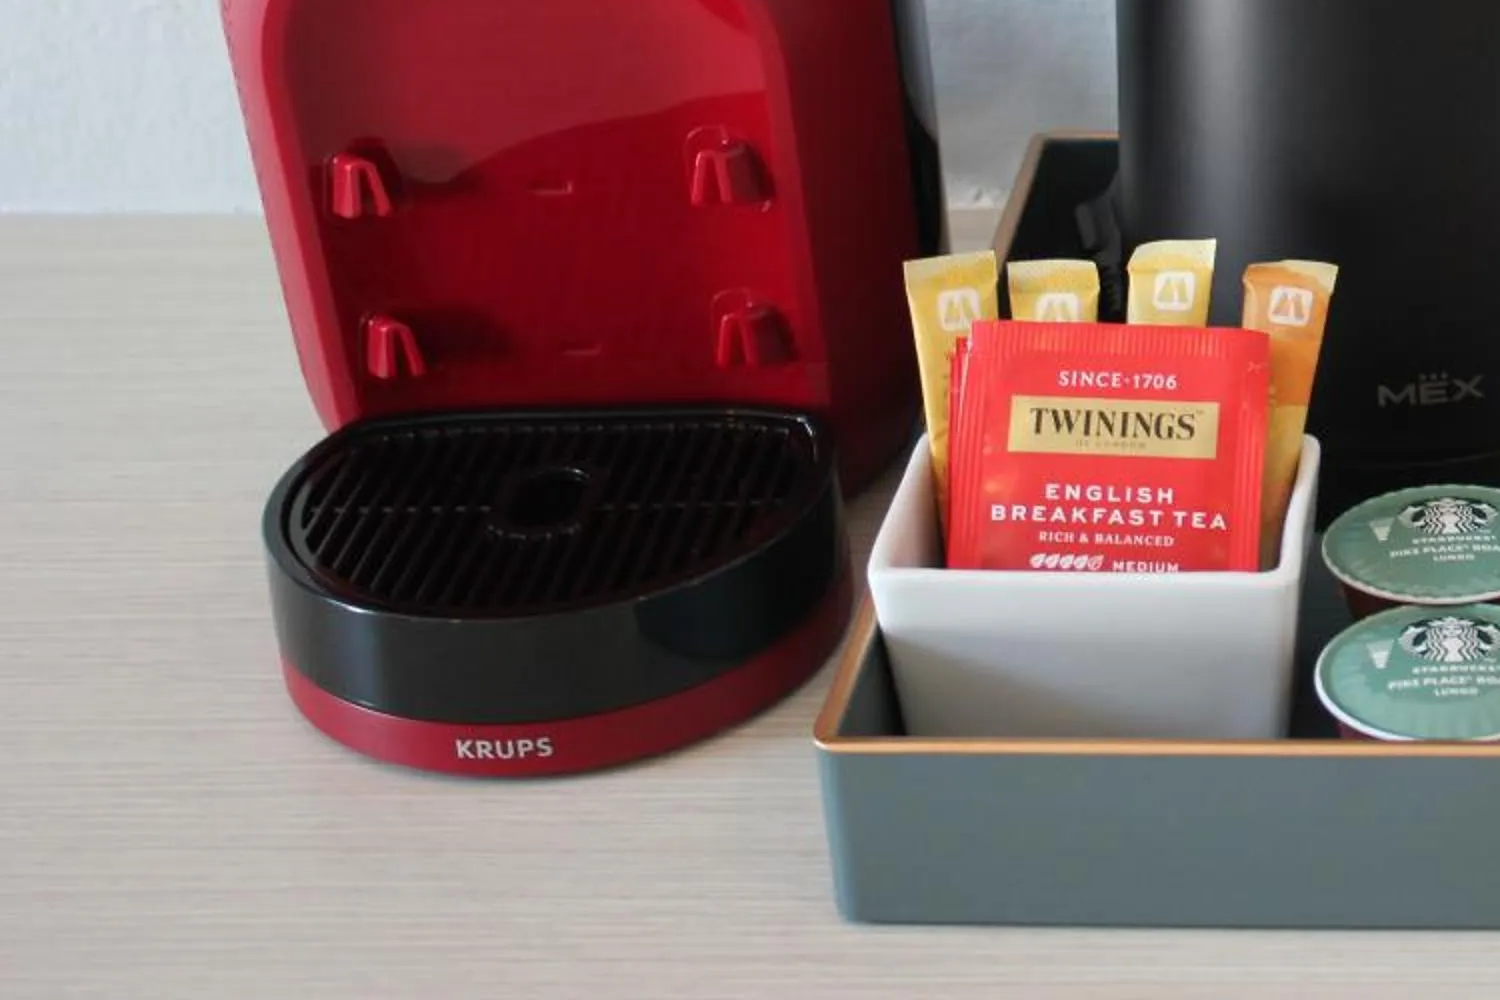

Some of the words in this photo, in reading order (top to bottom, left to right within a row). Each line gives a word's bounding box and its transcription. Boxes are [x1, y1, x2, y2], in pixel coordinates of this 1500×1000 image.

[1030, 407, 1196, 441] TWININGS
[1045, 483, 1174, 505] ENGLISH
[991, 504, 1165, 526] BREAKFAST
[1173, 510, 1227, 530] TEA
[1039, 531, 1074, 544] RICH
[1079, 532, 1089, 544] &
[1095, 533, 1175, 548] BALANCED
[1112, 560, 1180, 573] MEDIUM
[456, 738, 553, 759] KRUPS
